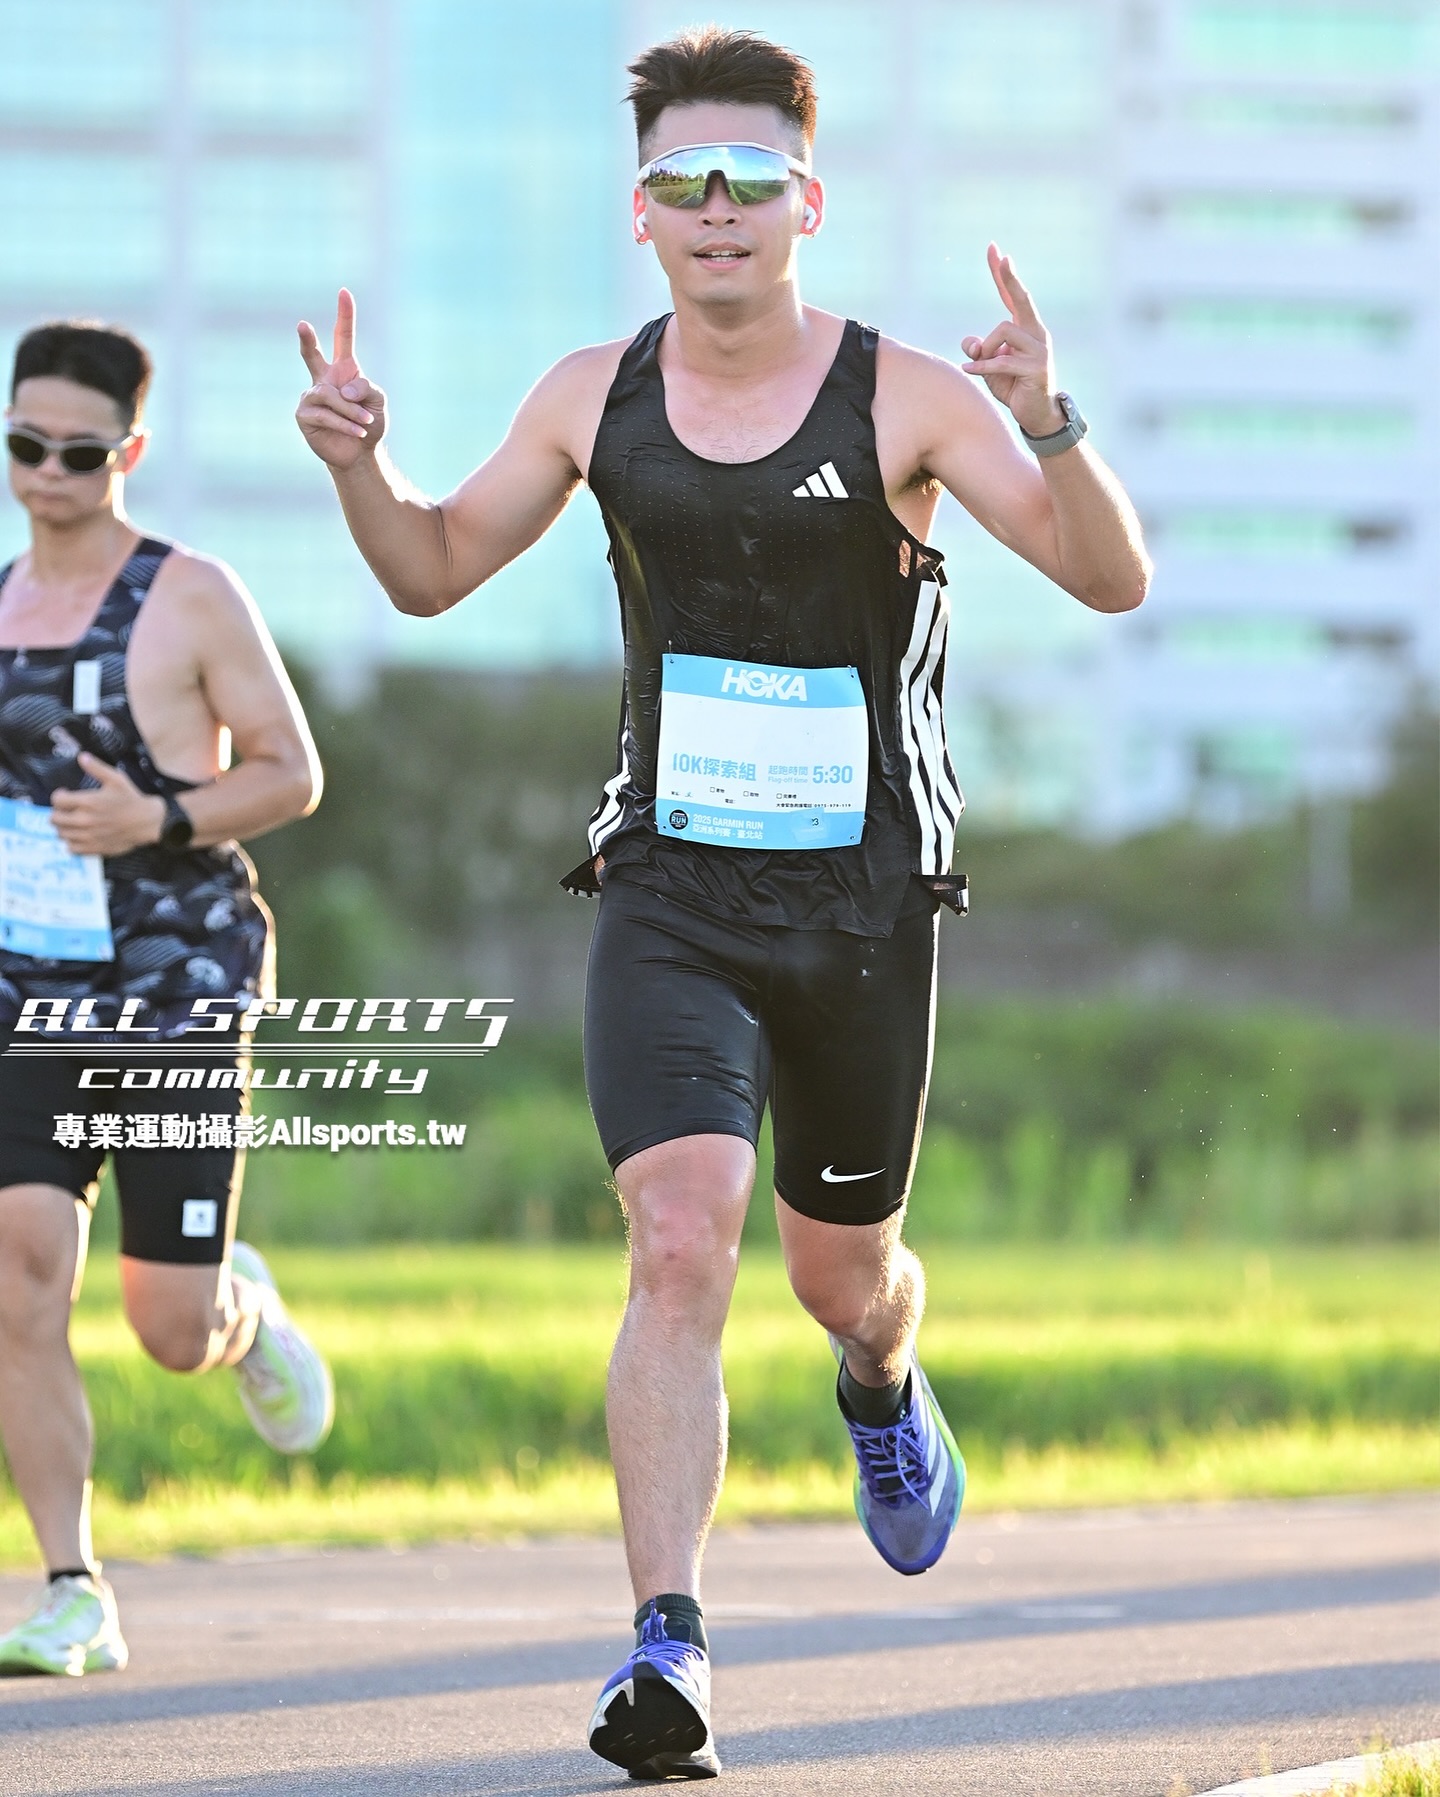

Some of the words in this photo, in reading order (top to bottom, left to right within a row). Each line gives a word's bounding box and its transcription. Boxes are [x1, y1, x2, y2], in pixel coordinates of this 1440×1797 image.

[721, 667, 807, 701] HOKA
[673, 753, 757, 781] 10K探索組
[768, 765, 809, 776] 起跑時間
[812, 765, 853, 784] 5:30
[768, 776, 793, 784] Flag-off
[671, 816, 687, 825] RUN
[693, 814, 711, 825] 2025
[712, 817, 744, 829] GARMIN
[746, 820, 764, 830] RUN
